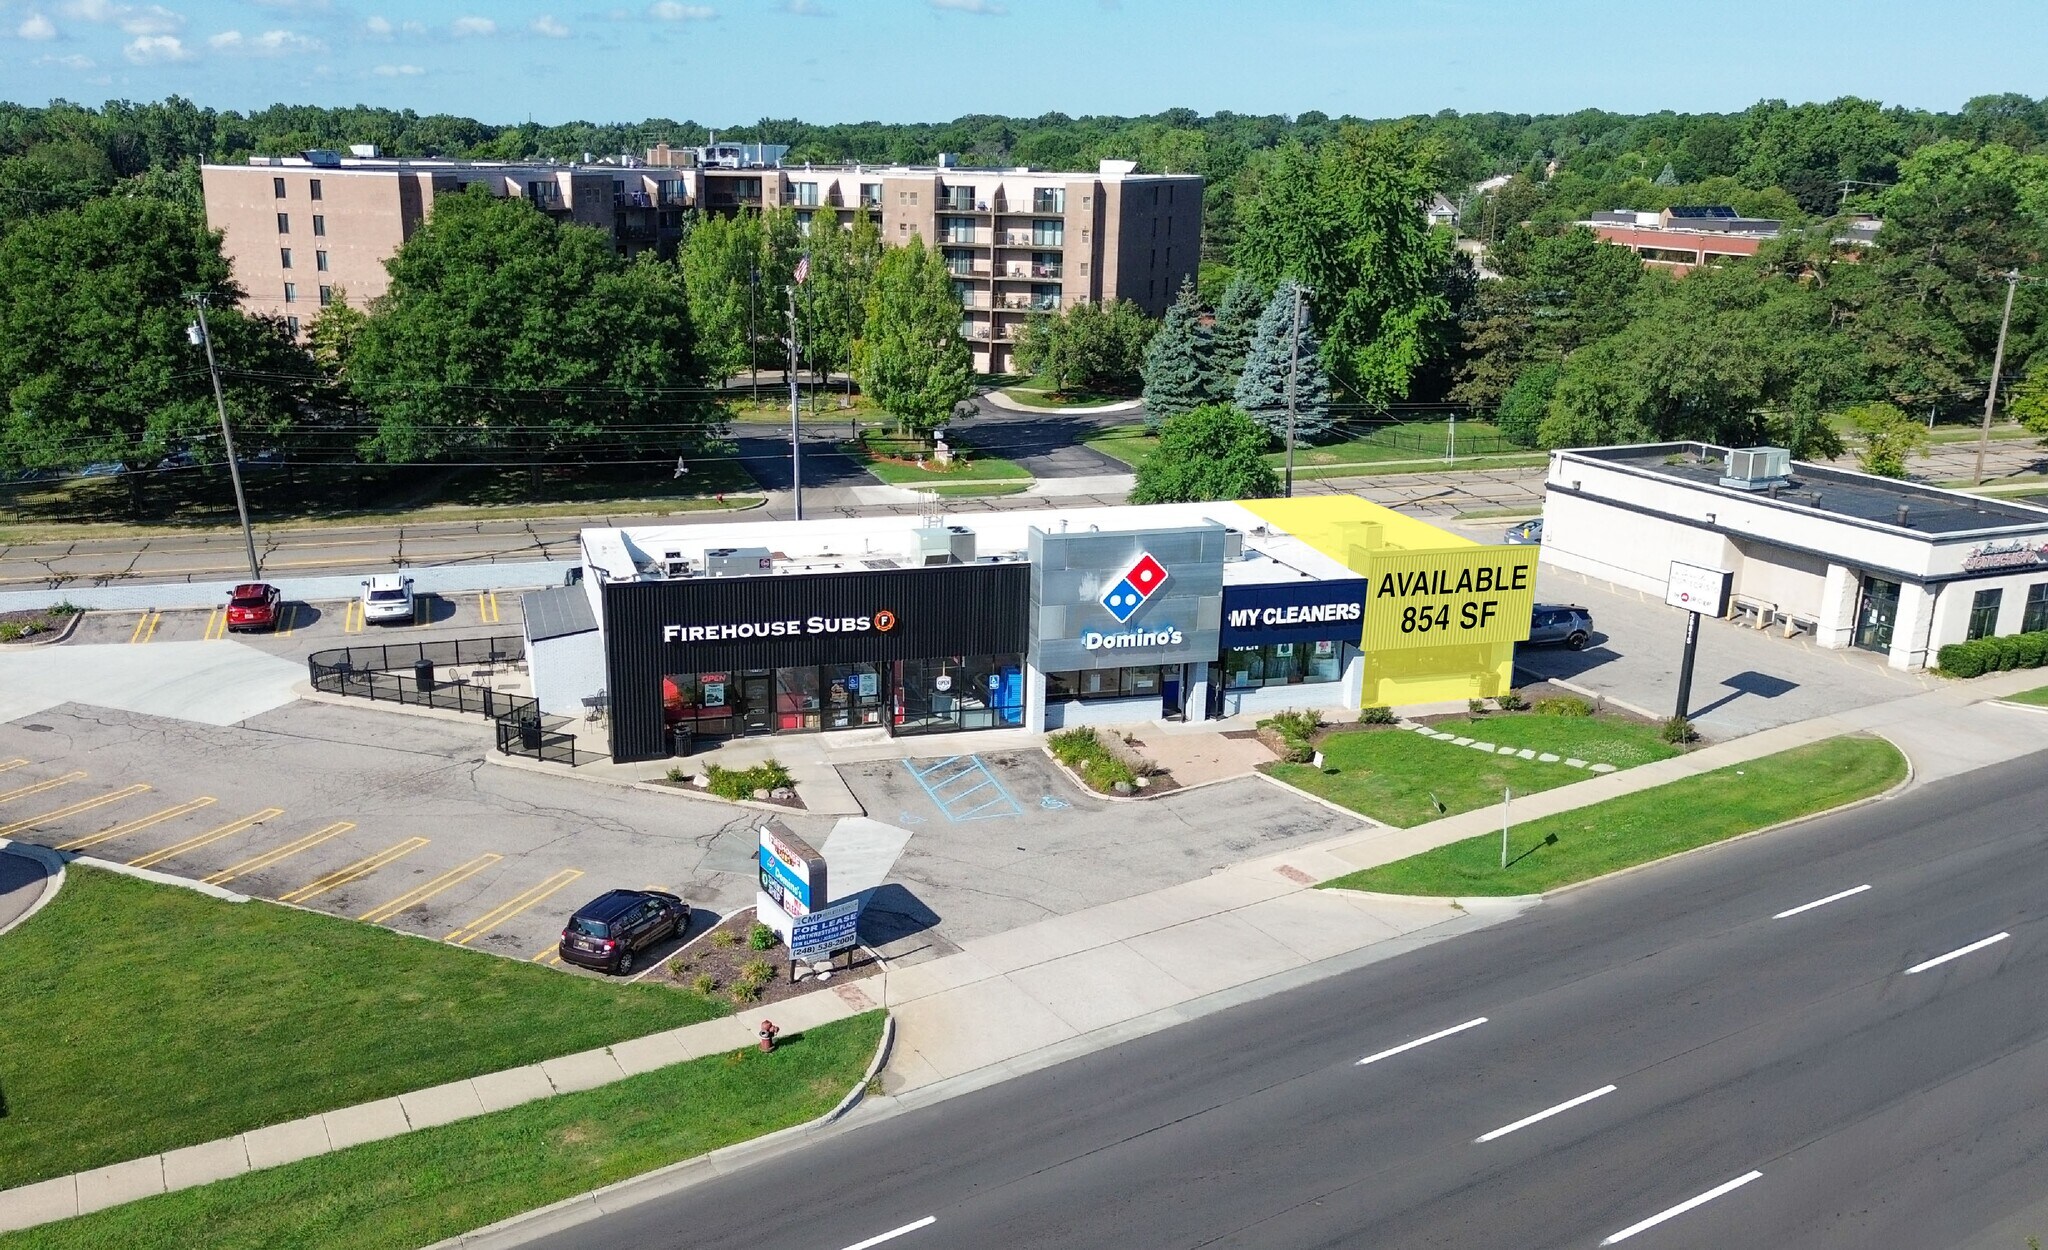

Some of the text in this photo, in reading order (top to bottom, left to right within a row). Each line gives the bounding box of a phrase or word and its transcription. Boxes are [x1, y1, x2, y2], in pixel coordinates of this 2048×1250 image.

[1229, 602, 1361, 627] MY CLEANERS
[663, 616, 871, 643] FIREHOUSE SUBS
[1085, 626, 1183, 650] Domino's
[701, 674, 727, 683] OPEN
[774, 867, 803, 899] Domino's
[793, 912, 858, 935] FOR LEASE
[801, 913, 823, 925] CMP
[793, 927, 839, 942] NORTHWESTERN
[839, 921, 856, 931] PLAZA
[793, 946, 815, 957] (248)
[817, 935, 855, 950] 538-2000
